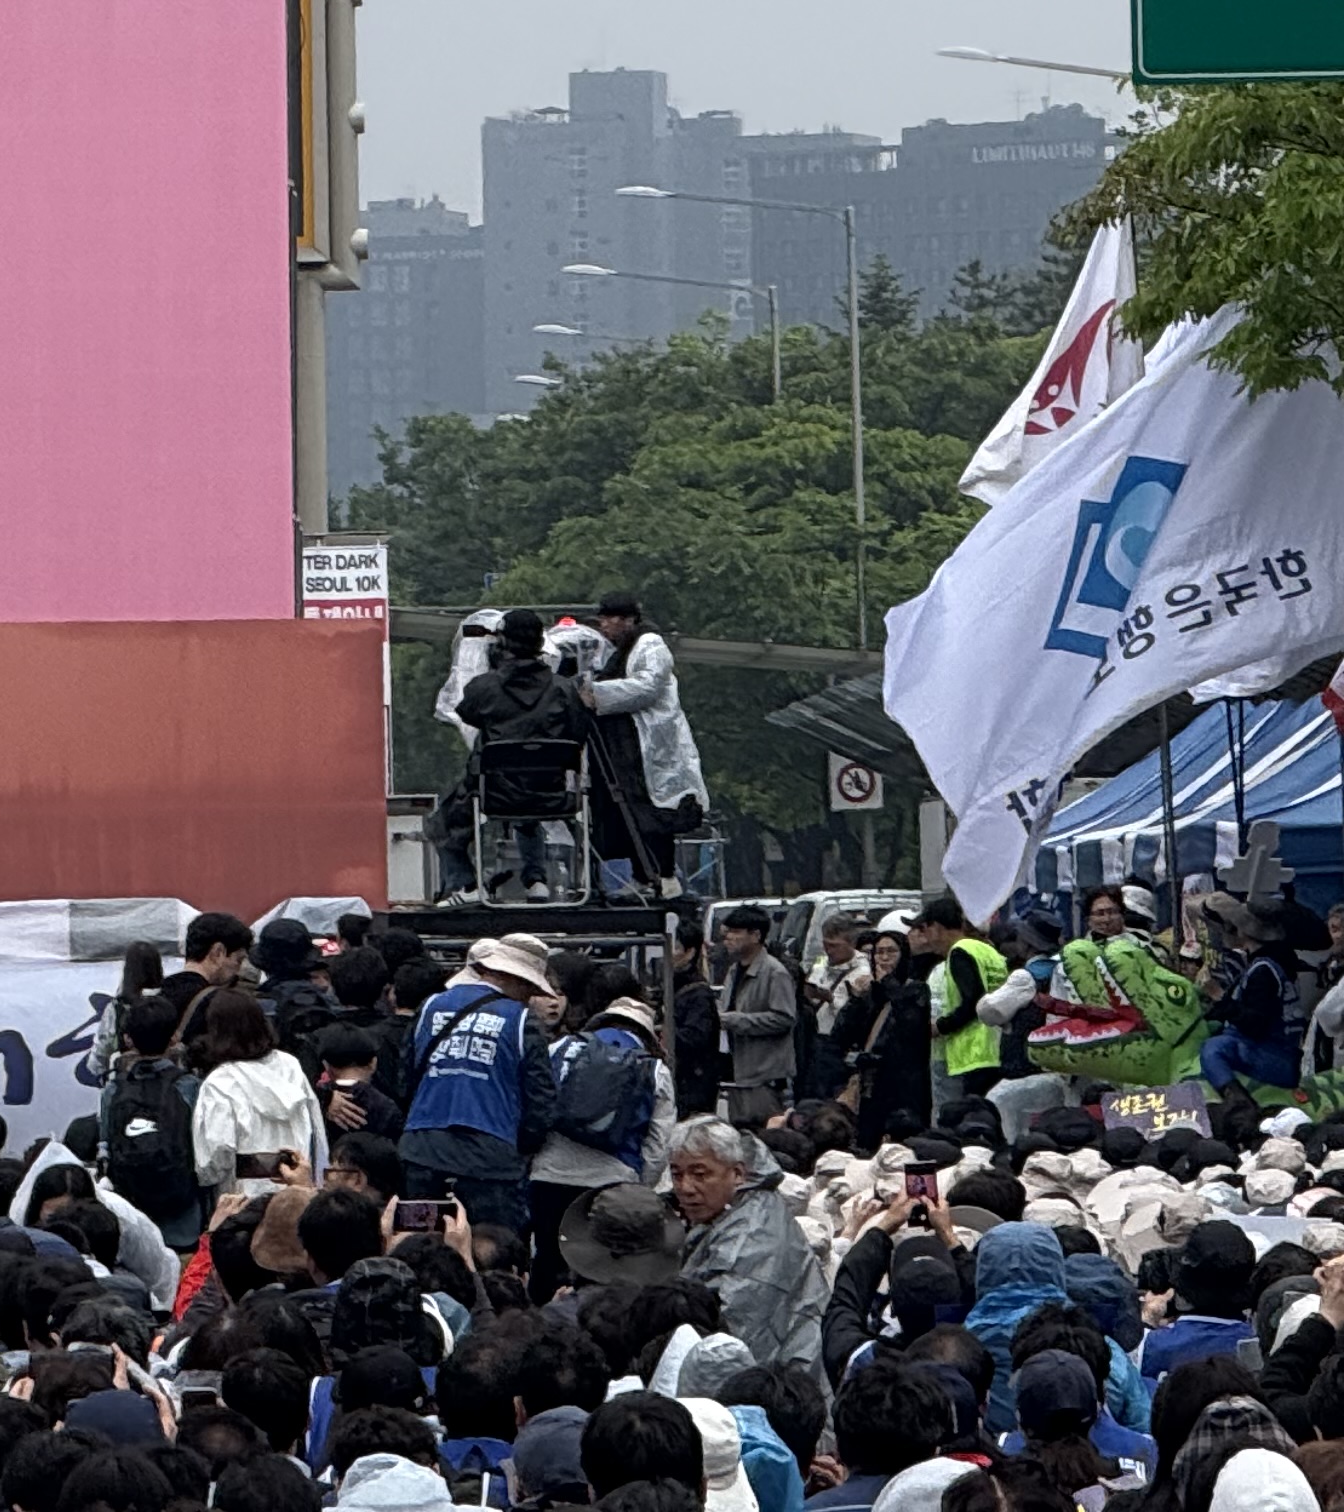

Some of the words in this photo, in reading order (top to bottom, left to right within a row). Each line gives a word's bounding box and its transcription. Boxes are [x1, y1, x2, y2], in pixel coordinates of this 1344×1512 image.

[303, 554, 332, 570] TER
[335, 552, 380, 570] DARK
[305, 576, 353, 593] SEOUL
[355, 574, 382, 592] 10K
